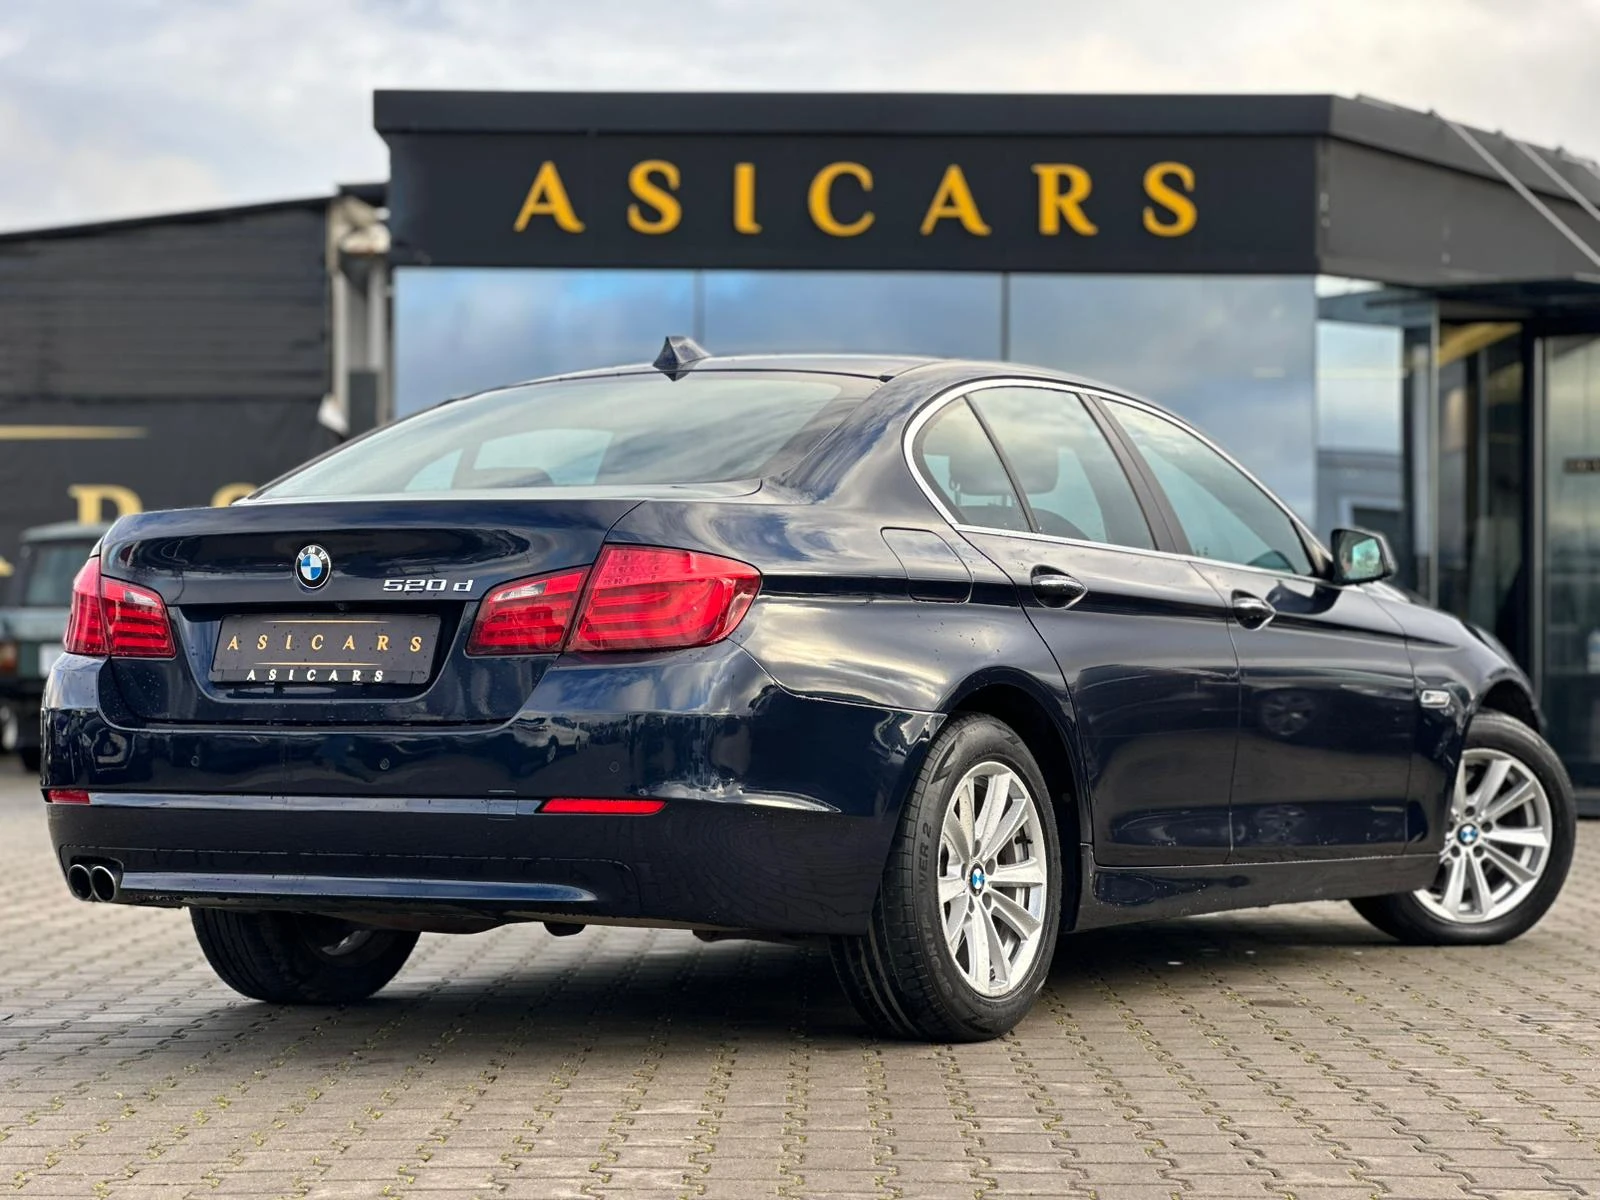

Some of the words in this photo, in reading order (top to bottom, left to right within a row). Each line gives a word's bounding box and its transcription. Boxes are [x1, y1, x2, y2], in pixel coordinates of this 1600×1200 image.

[514, 159, 1198, 237] ASICARS
[298, 546, 328, 561] BMW
[383, 579, 448, 592] 520
[453, 579, 474, 592] d
[227, 635, 422, 652] ASICARS
[246, 669, 384, 682] ASICARS
